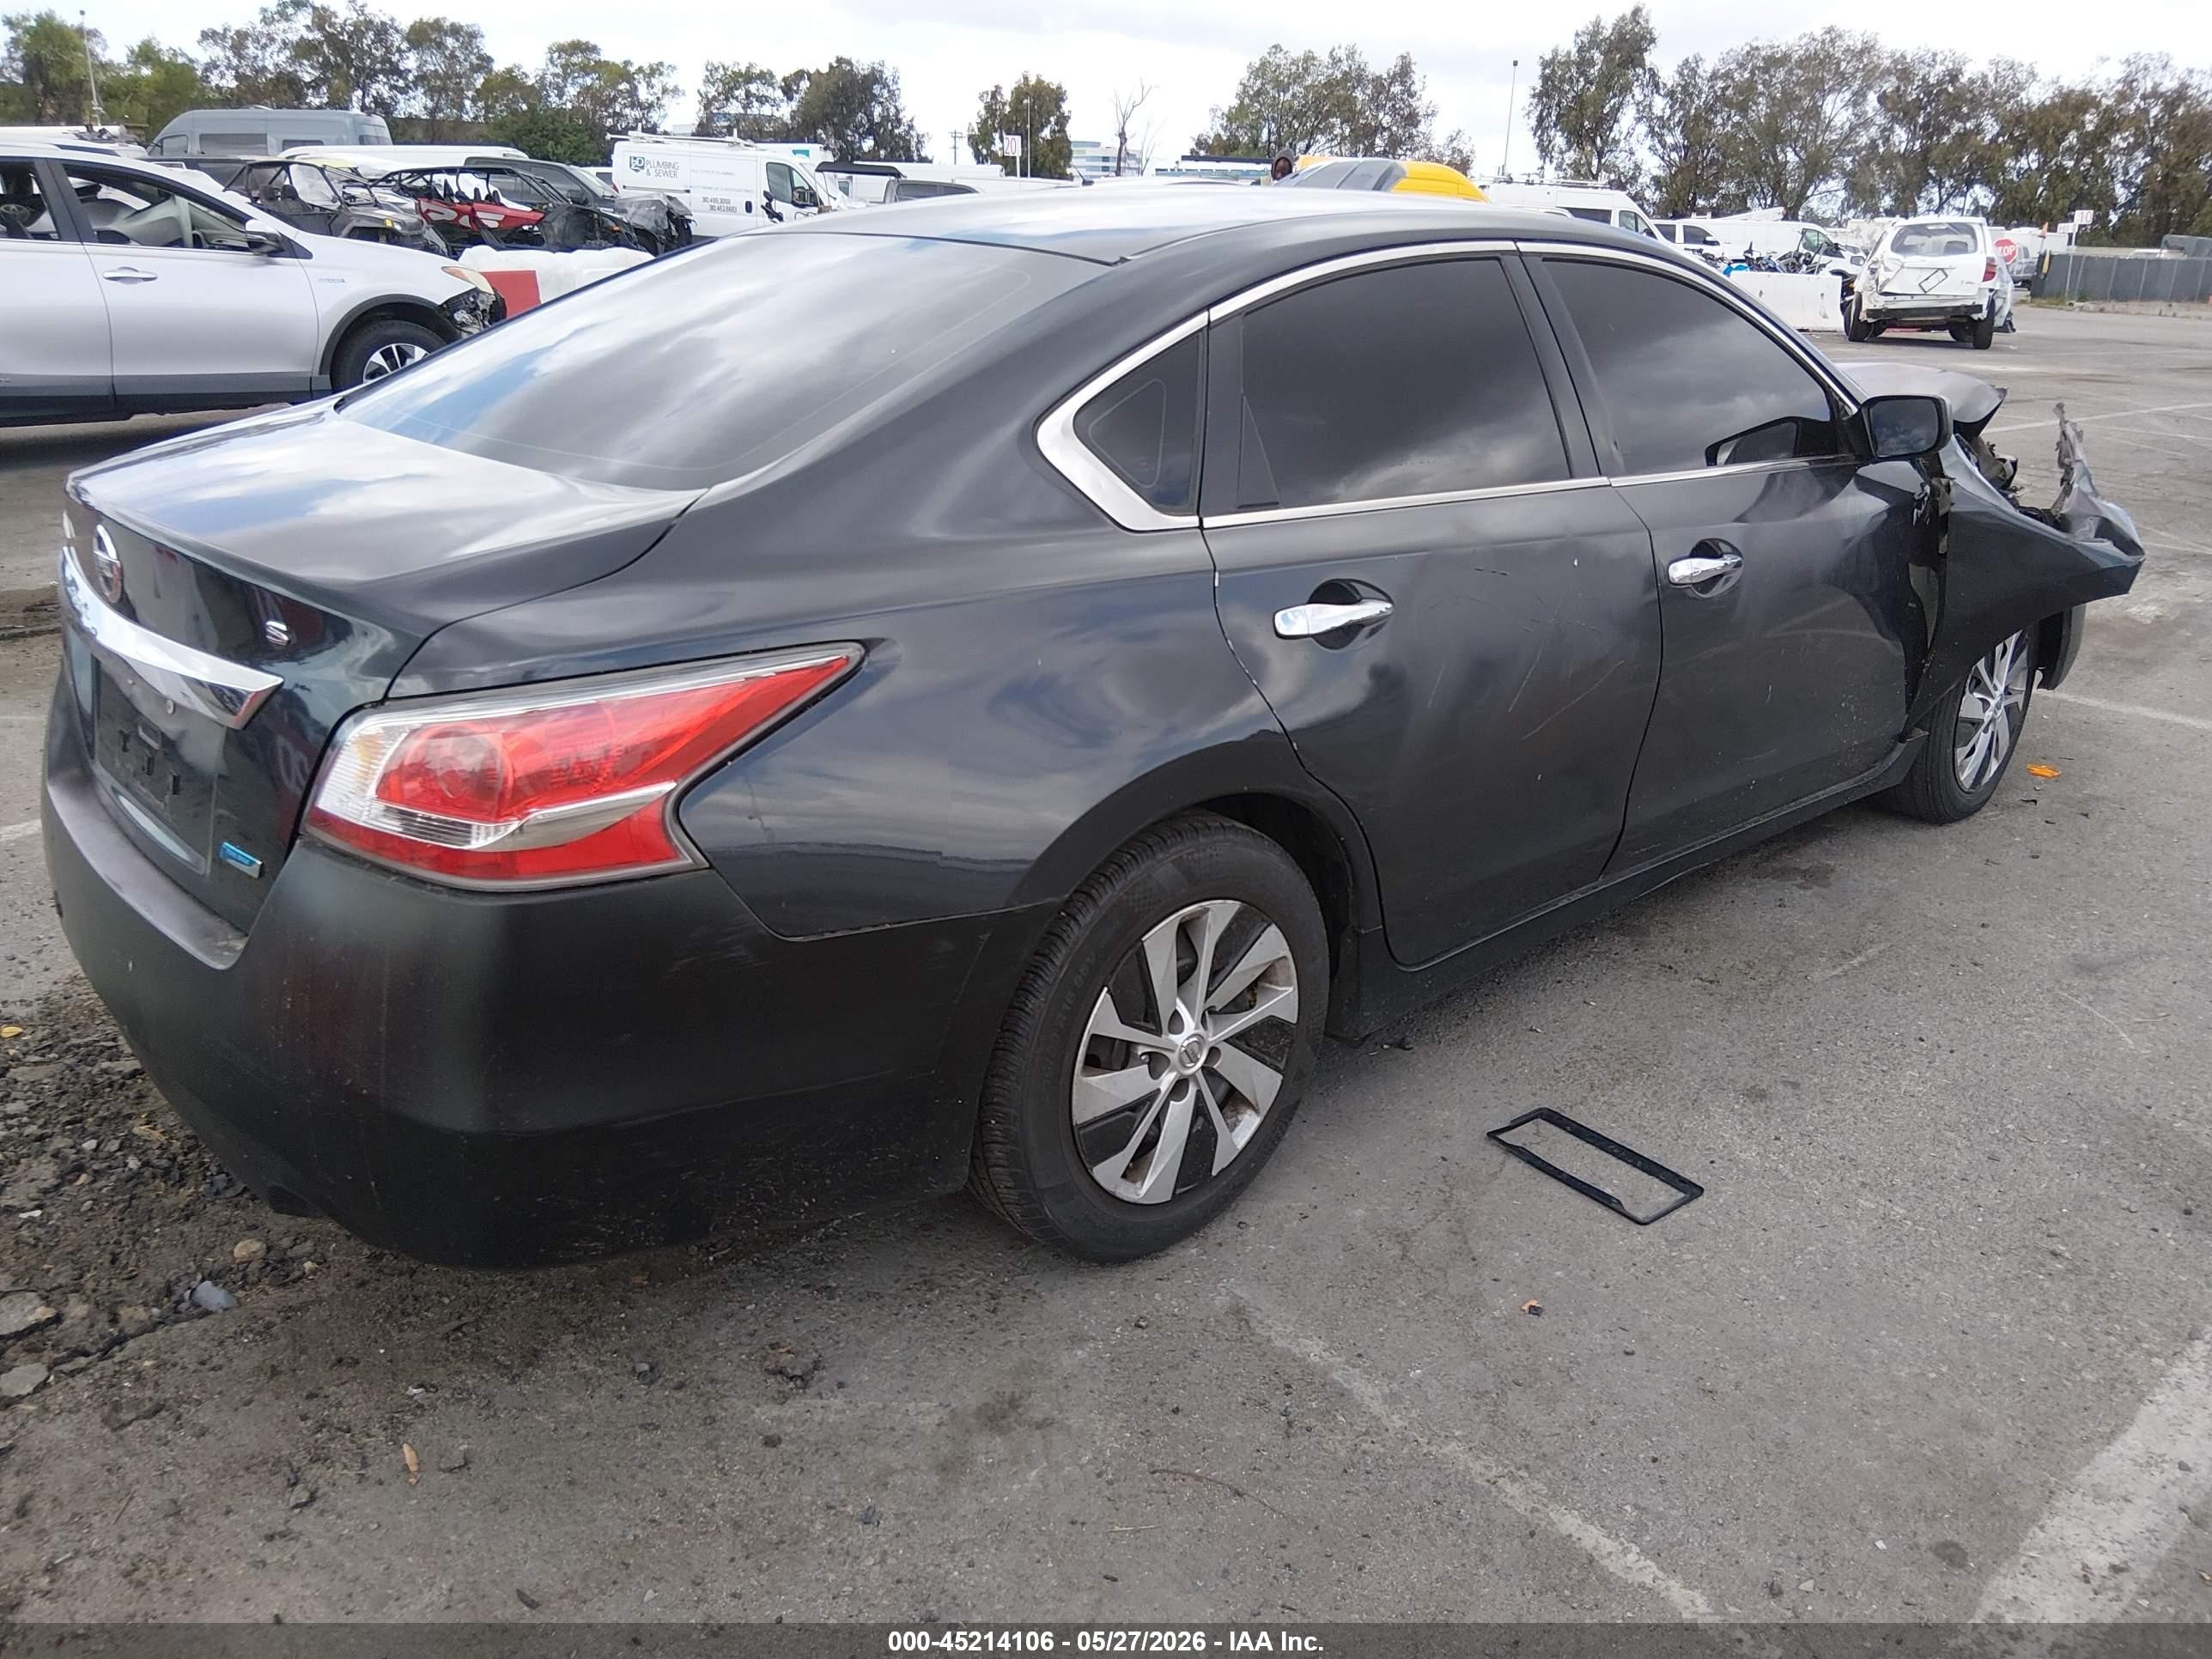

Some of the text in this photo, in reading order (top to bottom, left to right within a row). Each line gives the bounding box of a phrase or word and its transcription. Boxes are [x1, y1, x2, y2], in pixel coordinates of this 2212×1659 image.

[1005, 137, 1017, 155] 20
[646, 160, 679, 170] PLUMBING
[646, 168, 678, 179] & SEWER
[2081, 211, 2092, 223] 10
